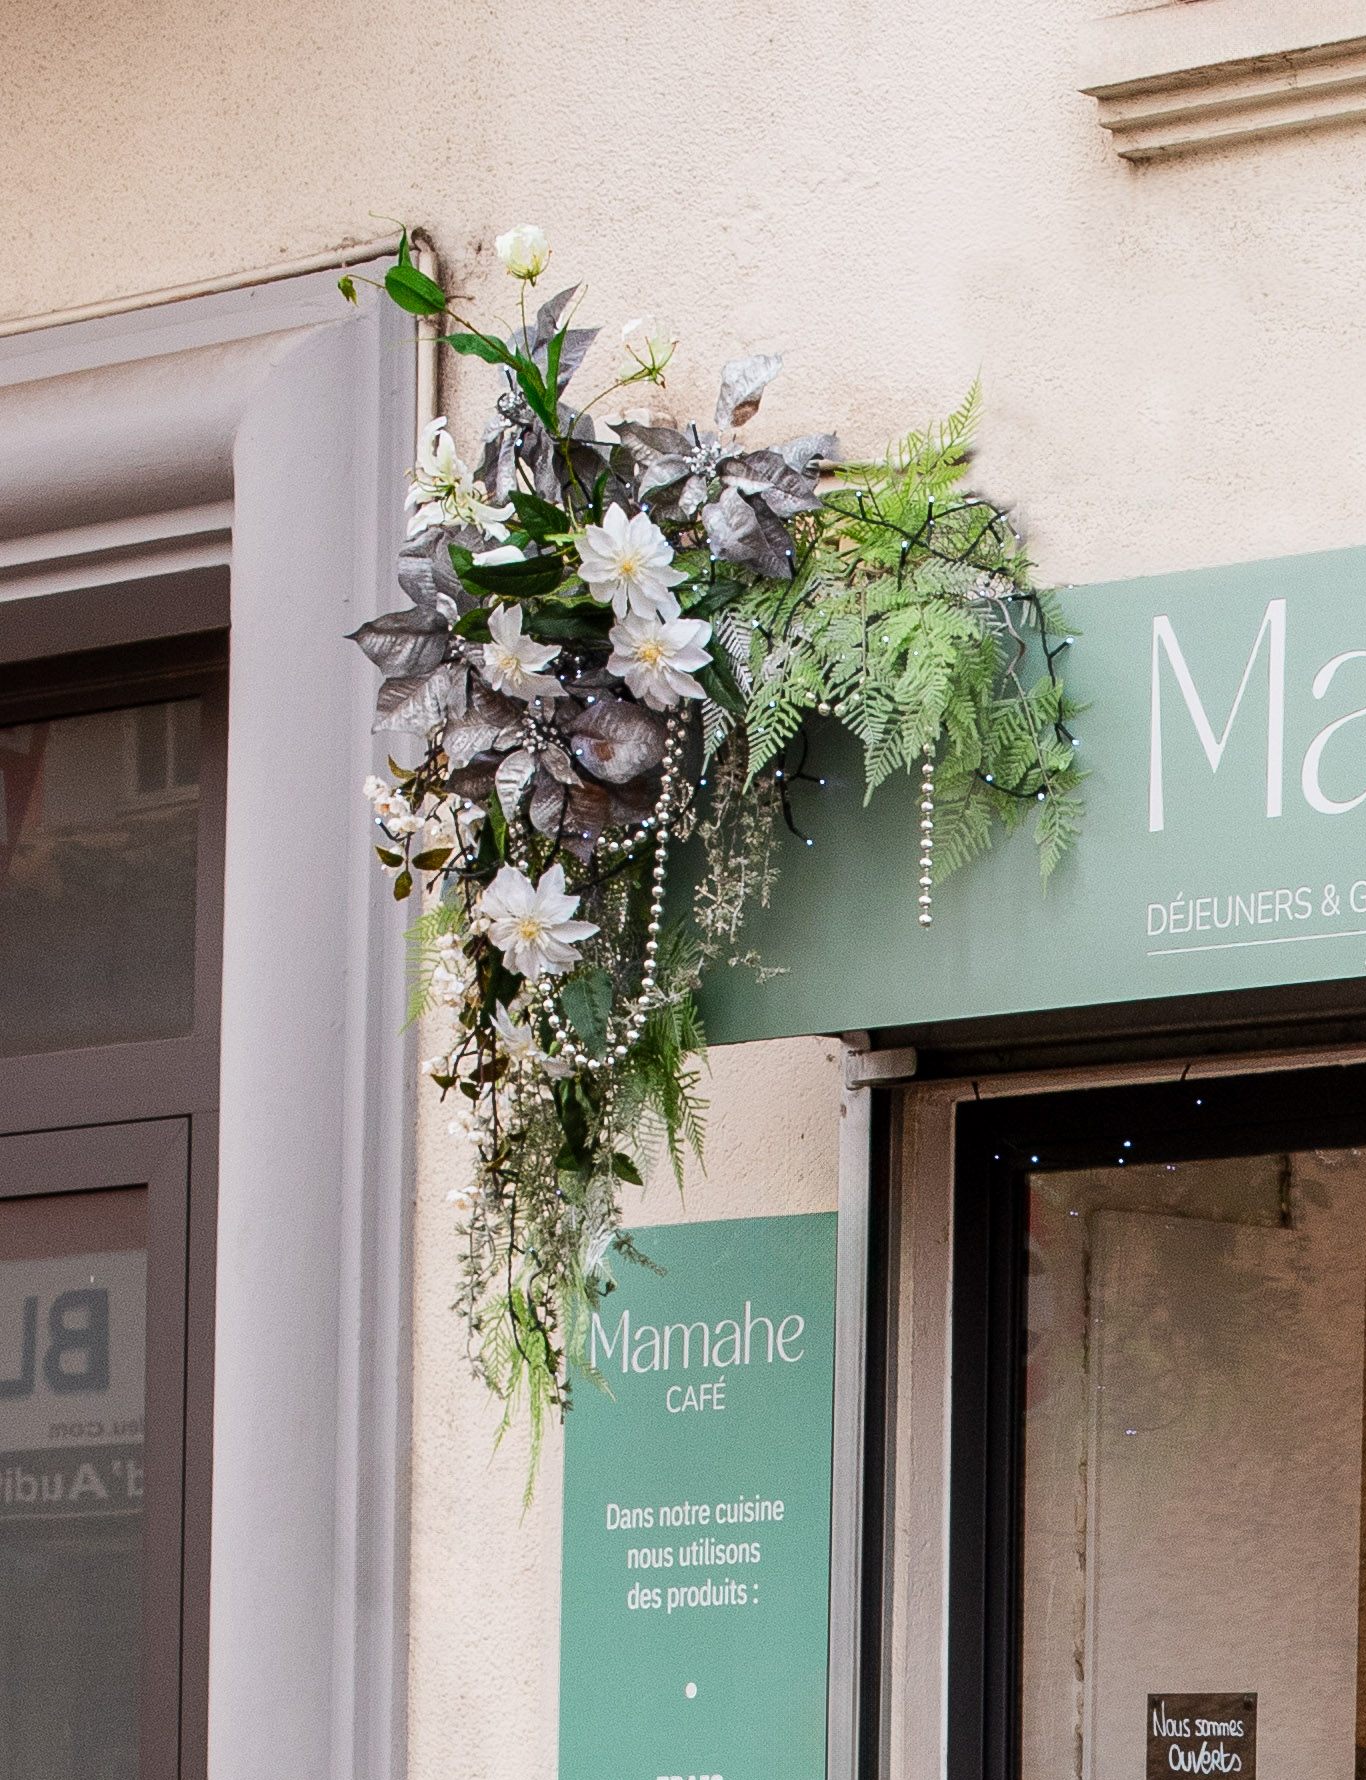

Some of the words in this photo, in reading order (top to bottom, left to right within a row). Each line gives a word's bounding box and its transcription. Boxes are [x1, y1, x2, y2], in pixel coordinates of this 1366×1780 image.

[1144, 885, 1313, 940] DÉJEUNERS
[1319, 882, 1344, 921] &
[665, 1375, 726, 1414] CAFÉ
[605, 1501, 655, 1531] Dans
[658, 1499, 712, 1528] notre
[714, 1495, 786, 1526] cuisine
[626, 1543, 674, 1570] nous
[678, 1539, 761, 1568] utilisons
[626, 1581, 662, 1611] des
[666, 1581, 748, 1614] produits
[1153, 1700, 1191, 1738] Nous
[1195, 1718, 1245, 1737] sommes
[1168, 1740, 1243, 1775] Ouverts
